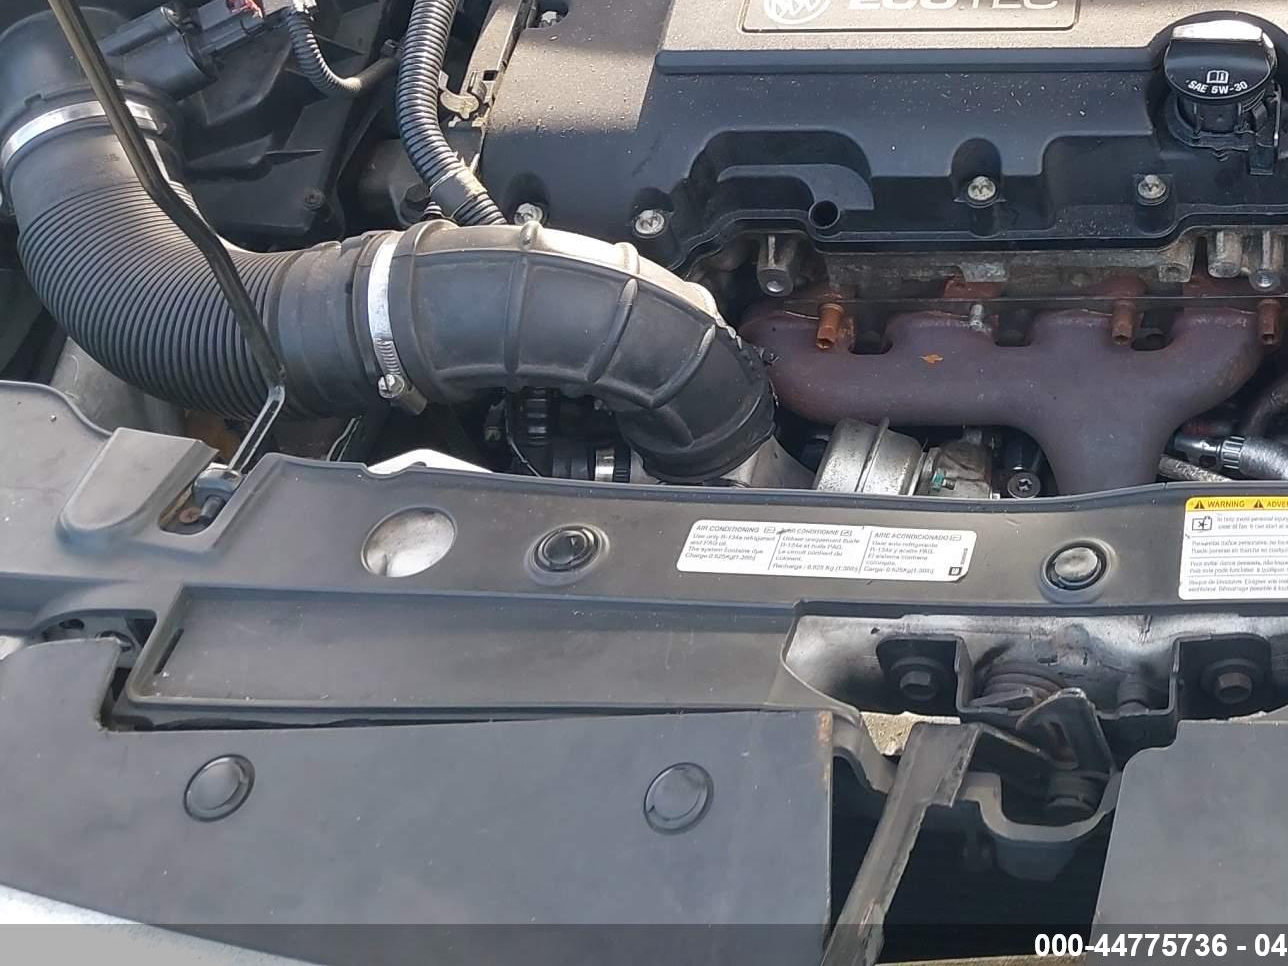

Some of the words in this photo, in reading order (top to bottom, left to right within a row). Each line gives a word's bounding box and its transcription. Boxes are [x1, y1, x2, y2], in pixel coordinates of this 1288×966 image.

[1187, 80, 1208, 93] SAE
[1211, 81, 1248, 94] 5W-30
[1207, 500, 1246, 508] WARNING
[709, 525, 760, 533] CONDITIONING
[874, 531, 891, 539] AIRE
[891, 533, 949, 541] ACONDICIONADO
